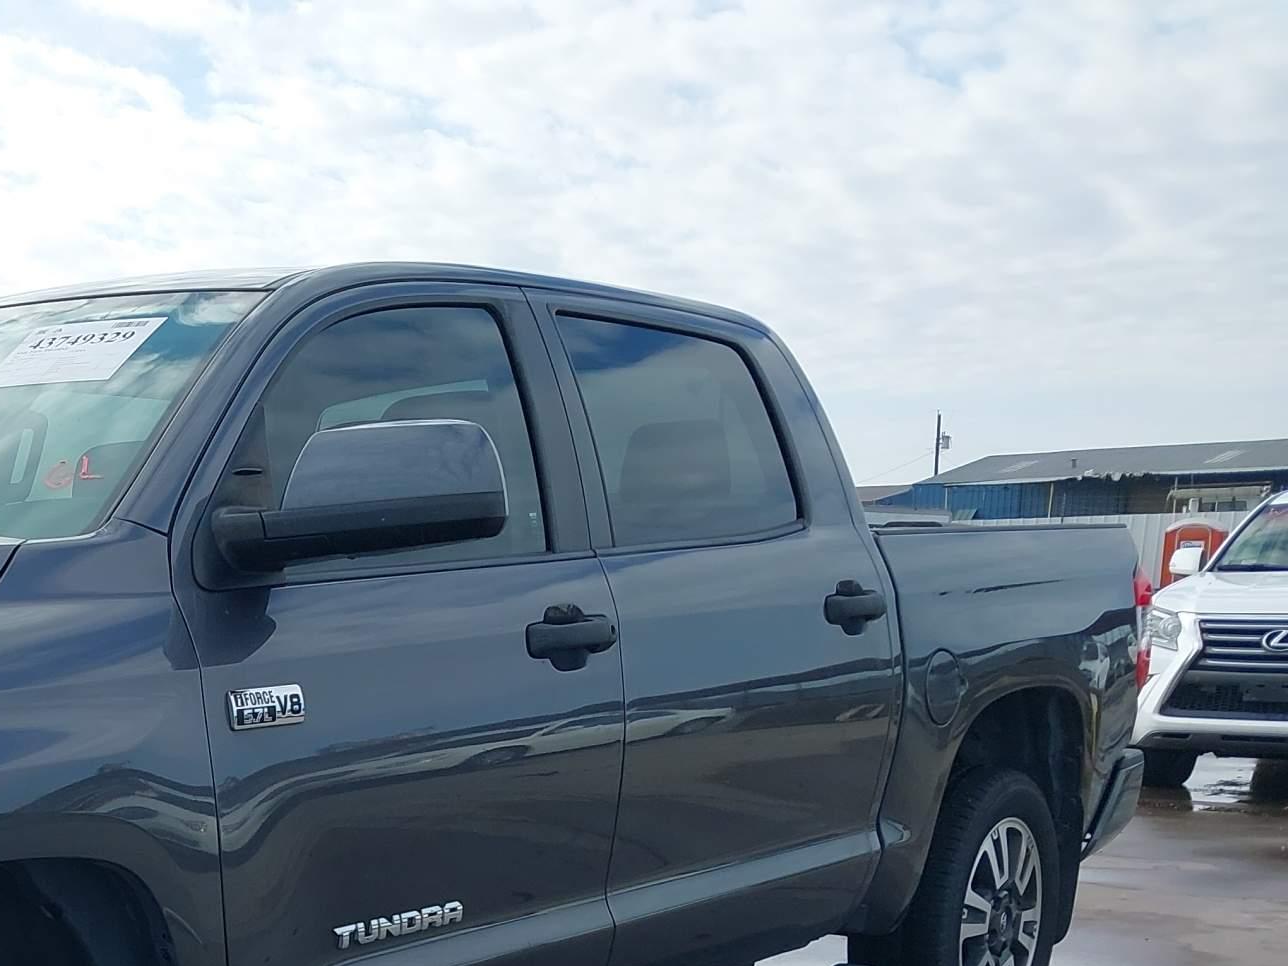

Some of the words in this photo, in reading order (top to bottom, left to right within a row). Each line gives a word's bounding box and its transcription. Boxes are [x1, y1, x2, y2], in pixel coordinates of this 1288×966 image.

[29, 330, 136, 350] 43749329
[276, 693, 302, 716] V8
[332, 900, 464, 949] TUNDRA
